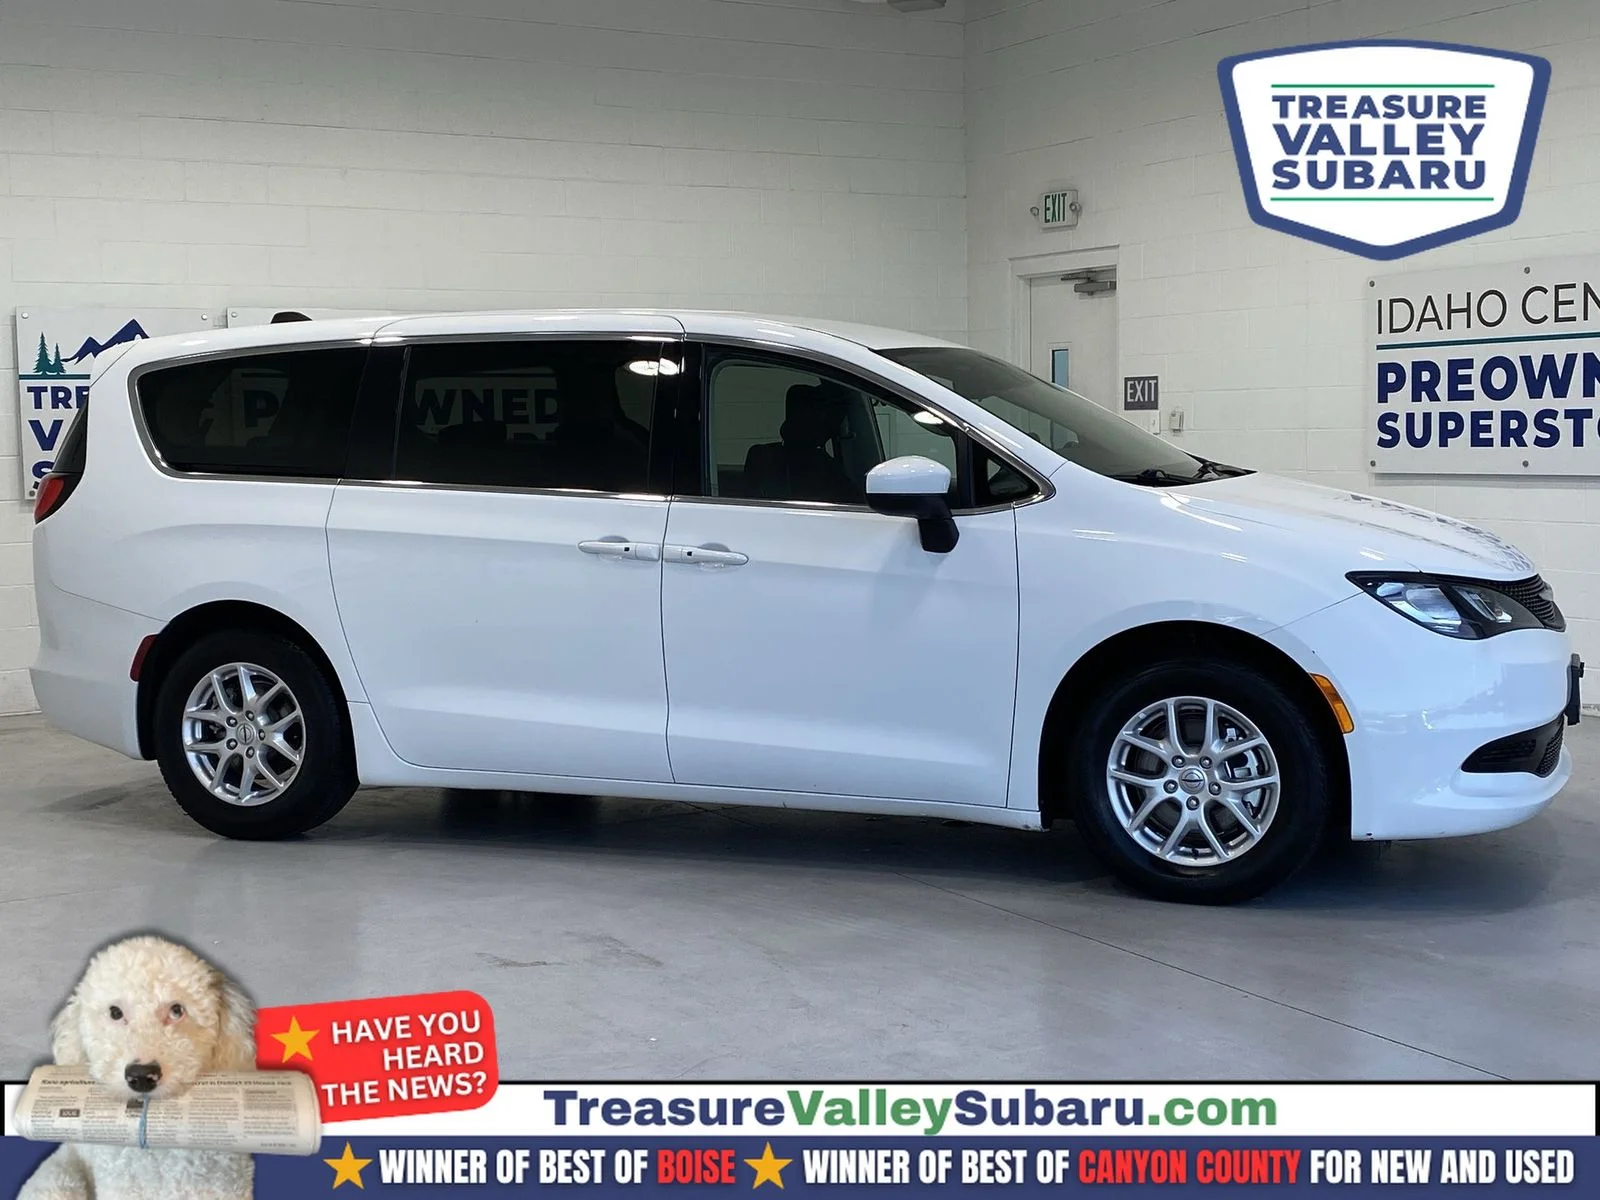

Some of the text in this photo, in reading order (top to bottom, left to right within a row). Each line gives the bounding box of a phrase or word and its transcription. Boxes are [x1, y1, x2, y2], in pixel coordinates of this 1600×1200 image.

[1043, 192, 1068, 223] EXIT
[1377, 289, 1507, 335] IDAHO
[1126, 379, 1157, 403] EXIT
[1376, 408, 1600, 449] SUPERST
